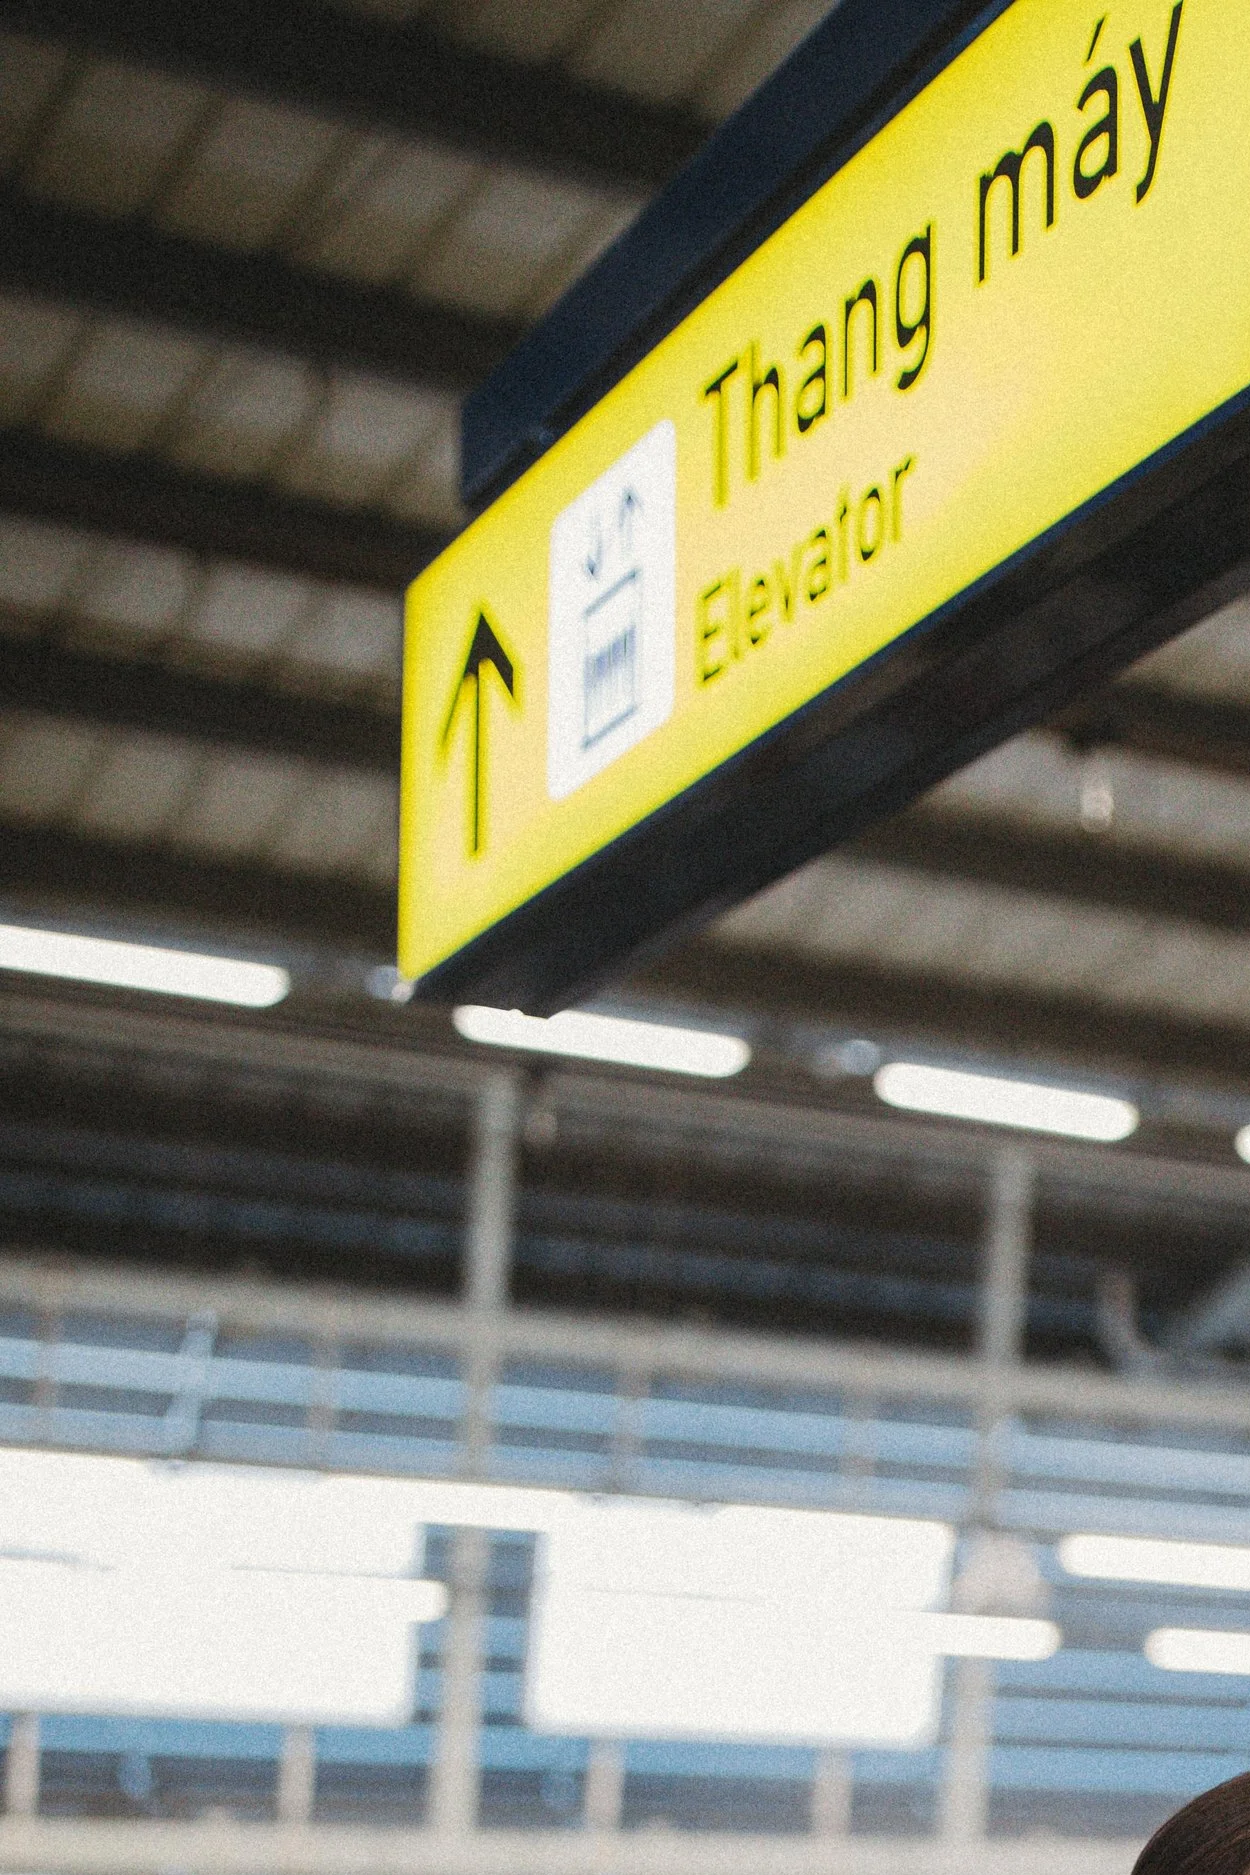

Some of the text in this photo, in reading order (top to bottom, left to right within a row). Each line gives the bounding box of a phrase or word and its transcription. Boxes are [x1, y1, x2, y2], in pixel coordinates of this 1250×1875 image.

[703, 0, 1183, 506] Thang máy
[698, 457, 914, 686] Elevator
